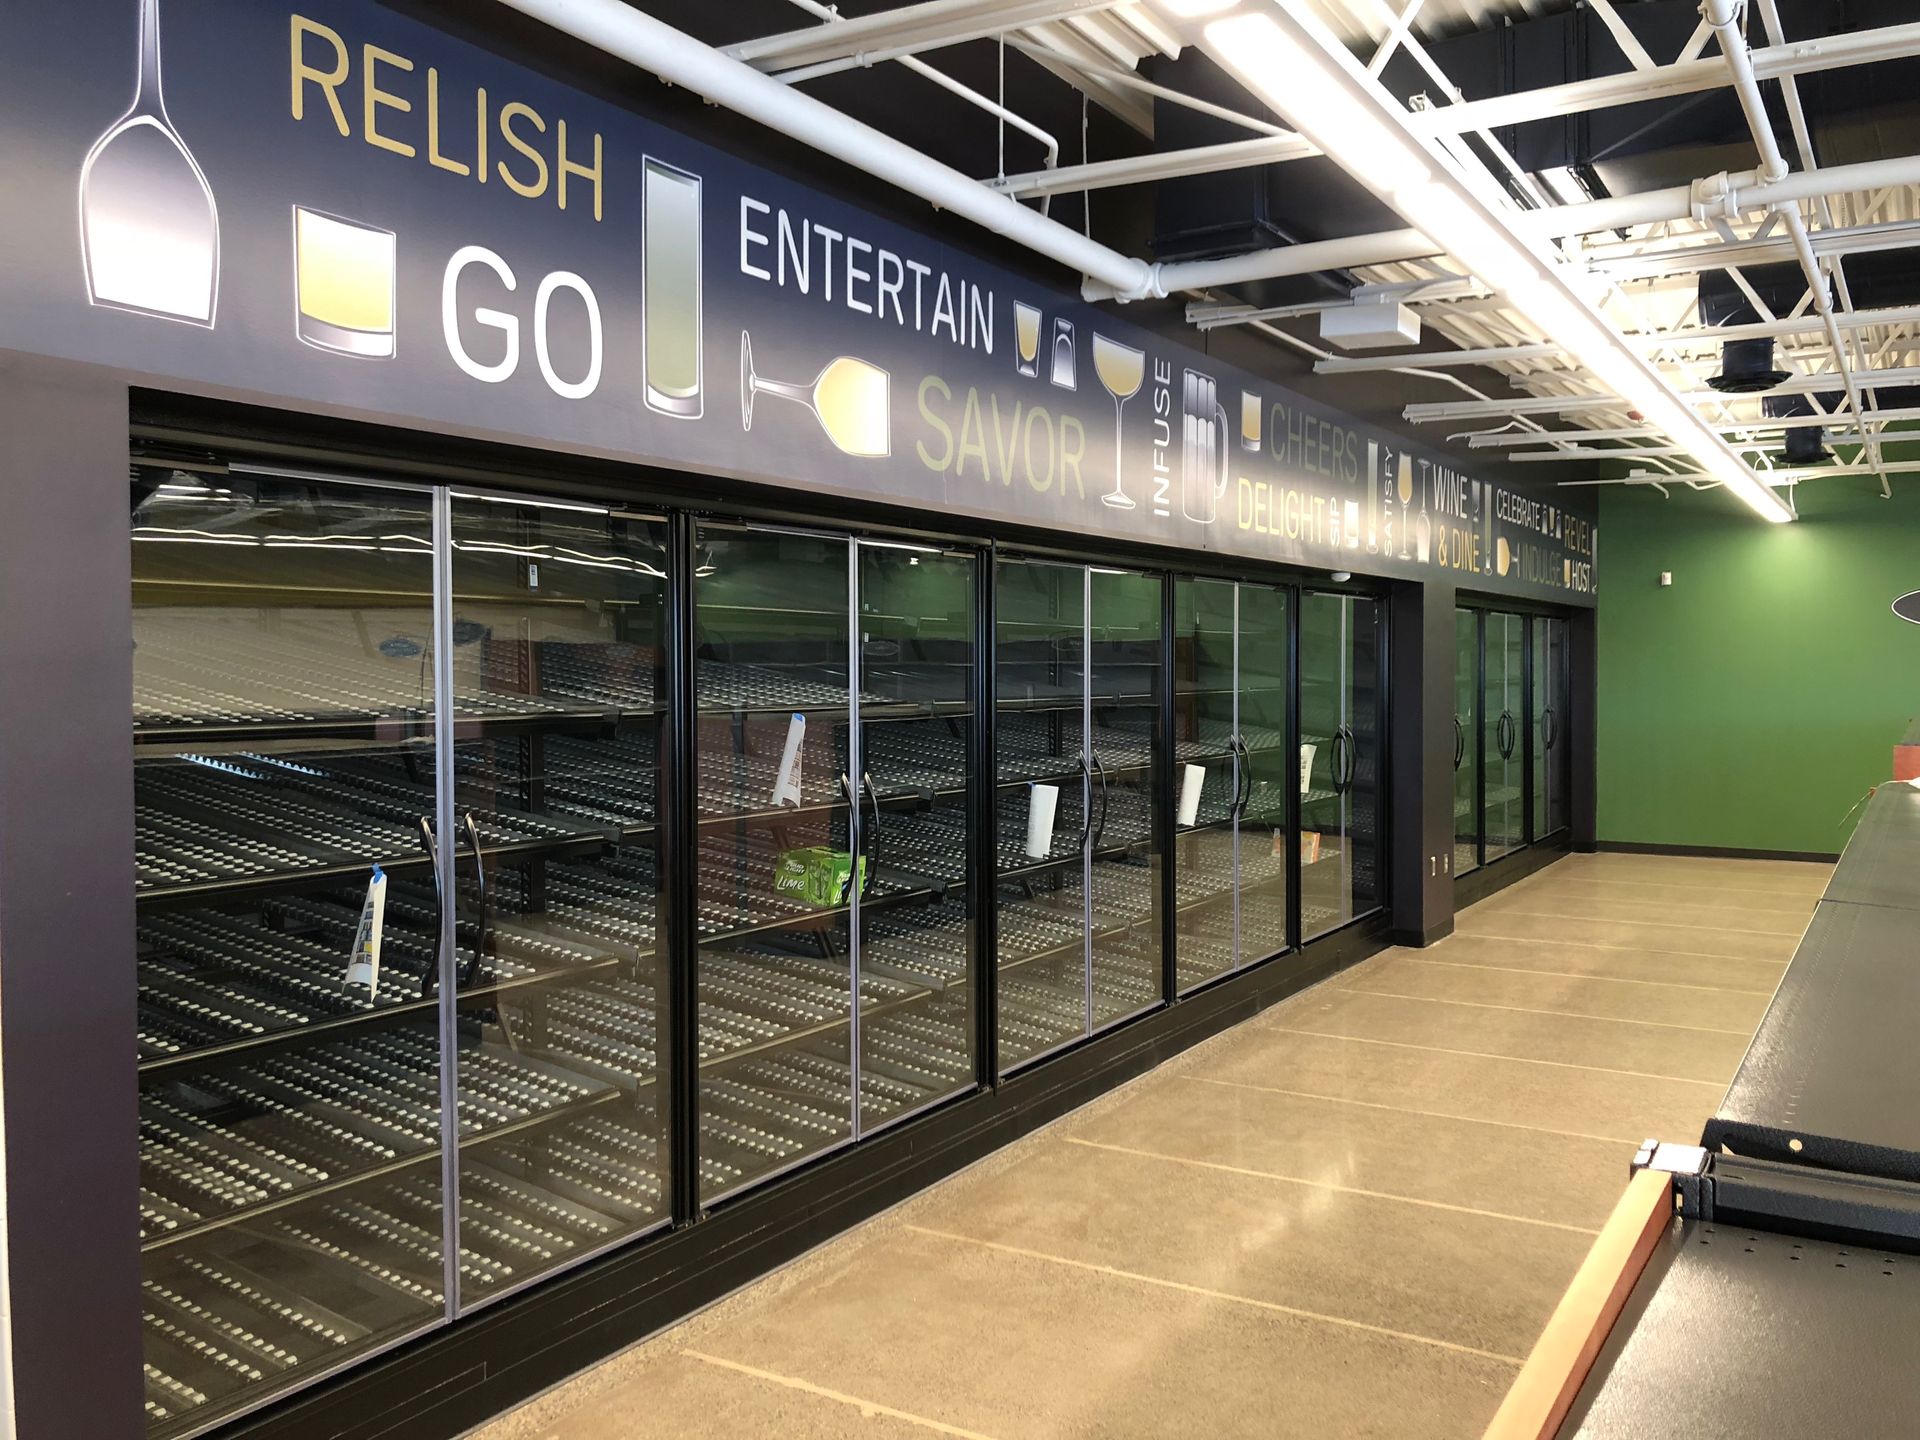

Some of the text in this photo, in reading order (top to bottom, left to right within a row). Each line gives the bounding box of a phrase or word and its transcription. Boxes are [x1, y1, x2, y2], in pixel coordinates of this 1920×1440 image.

[290, 14, 603, 222] RELISH
[740, 195, 994, 355] ENTERTAIN
[441, 244, 603, 399] GO
[915, 374, 1086, 500] SAVOR
[1153, 357, 1171, 516] INFUSE
[1270, 402, 1358, 483] CHEERS
[1238, 477, 1325, 544] DELIGHT
[1329, 497, 1340, 547] SIP
[1384, 446, 1393, 557] SATISFY
[1433, 464, 1467, 519] WINE
[1496, 488, 1540, 531] CELEBRATE
[1438, 525, 1480, 573] & DINE
[1522, 543, 1561, 587] INDULGE
[1564, 514, 1591, 556] REVEL
[1571, 560, 1591, 593] HOST
